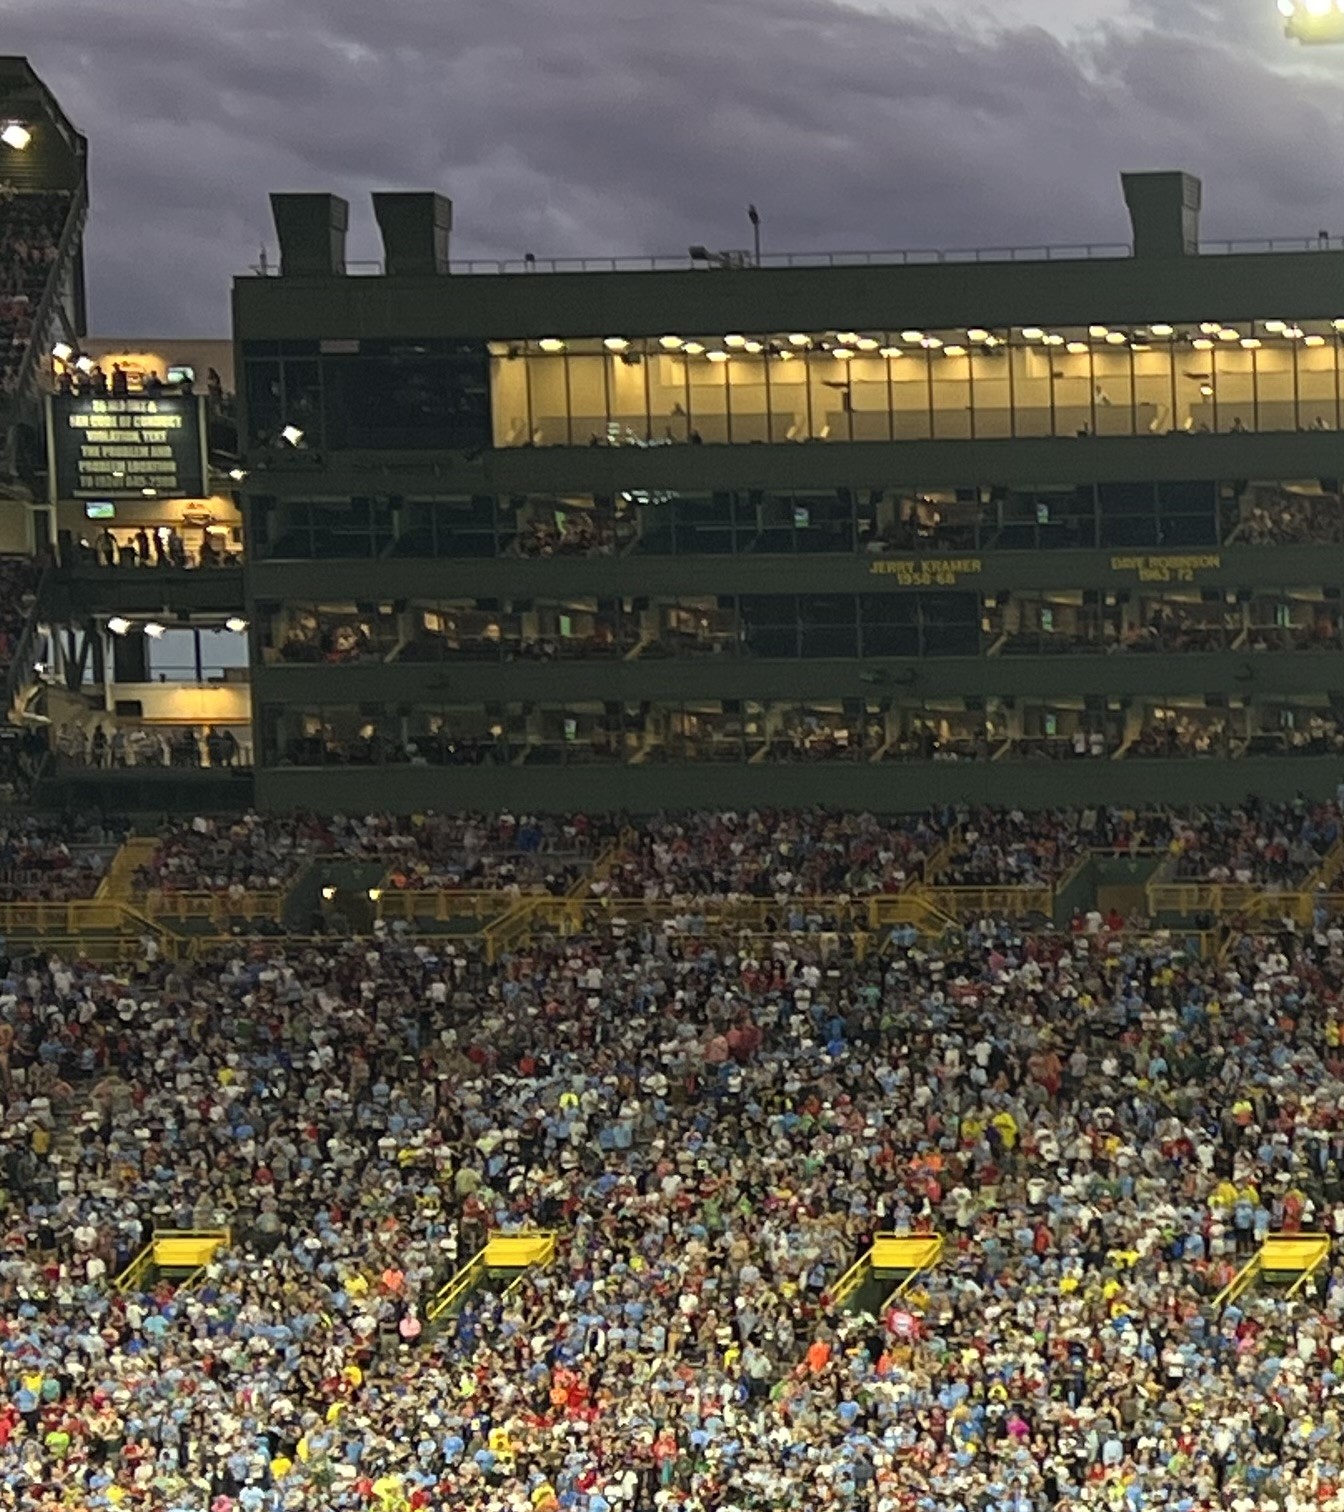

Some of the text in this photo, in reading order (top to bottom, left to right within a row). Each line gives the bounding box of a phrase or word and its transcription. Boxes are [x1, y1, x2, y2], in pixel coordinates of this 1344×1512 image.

[133, 415, 182, 428] CONDUCT
[869, 559, 981, 574] JERRY KRAMER
[1110, 555, 1220, 570] DAVE ROBINSON
